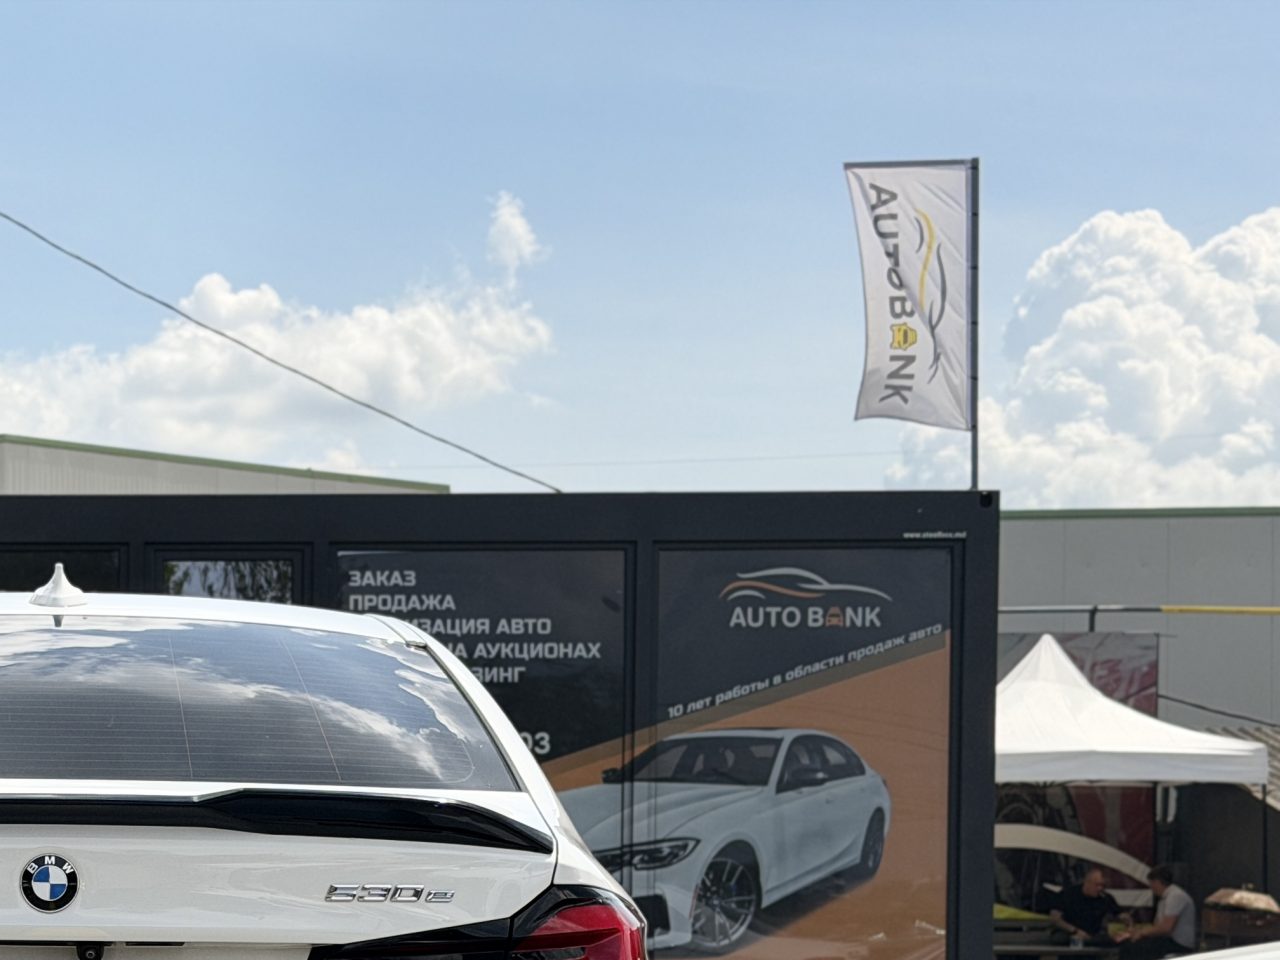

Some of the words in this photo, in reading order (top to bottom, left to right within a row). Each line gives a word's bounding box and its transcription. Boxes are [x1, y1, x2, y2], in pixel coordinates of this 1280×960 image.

[348, 570, 417, 587] ЗАКАЗ
[348, 595, 456, 613] ПРОДАЖА
[729, 606, 801, 628] AUTO
[495, 618, 552, 635] АВТО
[473, 642, 601, 660] АУКЦИОНАХ
[667, 704, 684, 718] 10
[686, 696, 713, 712] лет
[715, 678, 770, 706] работы
[772, 674, 783, 686] в
[785, 653, 845, 681] области
[847, 634, 906, 661] продаж
[907, 623, 943, 642] авто
[26, 855, 74, 874] BMW
